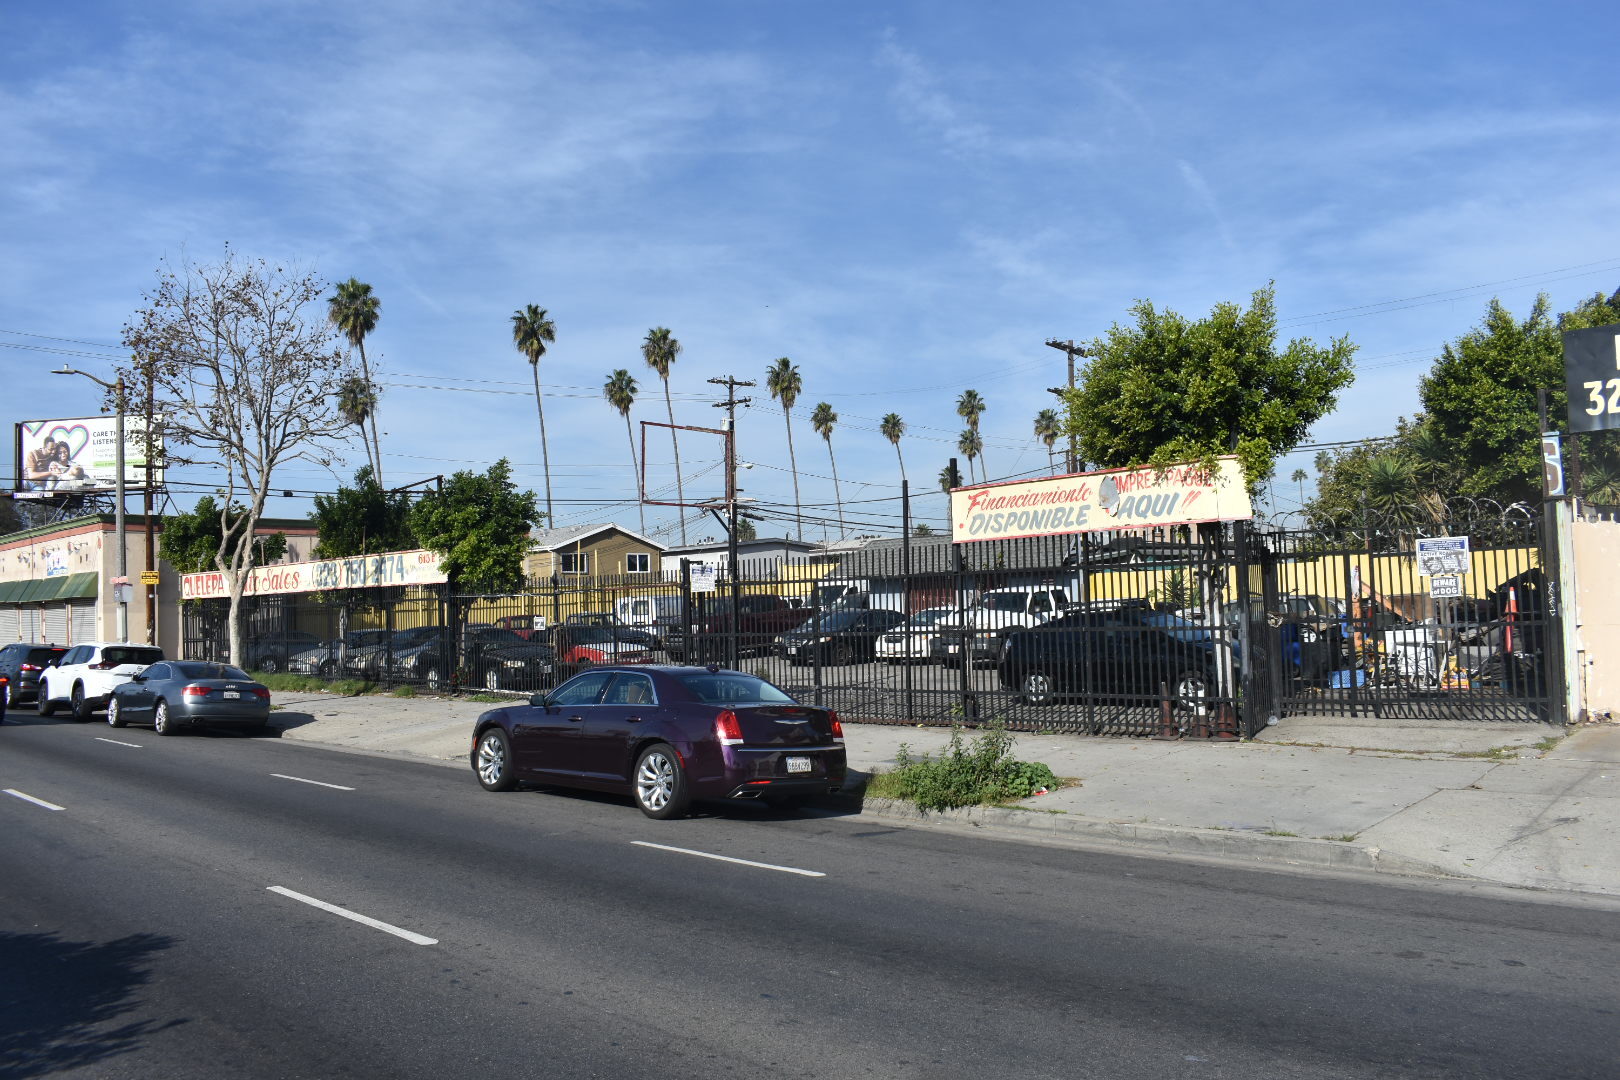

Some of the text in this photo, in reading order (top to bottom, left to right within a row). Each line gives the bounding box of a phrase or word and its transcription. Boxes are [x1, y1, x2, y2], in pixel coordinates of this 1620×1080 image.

[92, 430, 109, 438] CARE
[967, 482, 1093, 520] Financiamiento
[969, 505, 1091, 535] DISPONIBLE
[184, 574, 225, 597] QUELEPA
[262, 568, 301, 592] Sales
[1433, 578, 1457, 587] BEWARE
